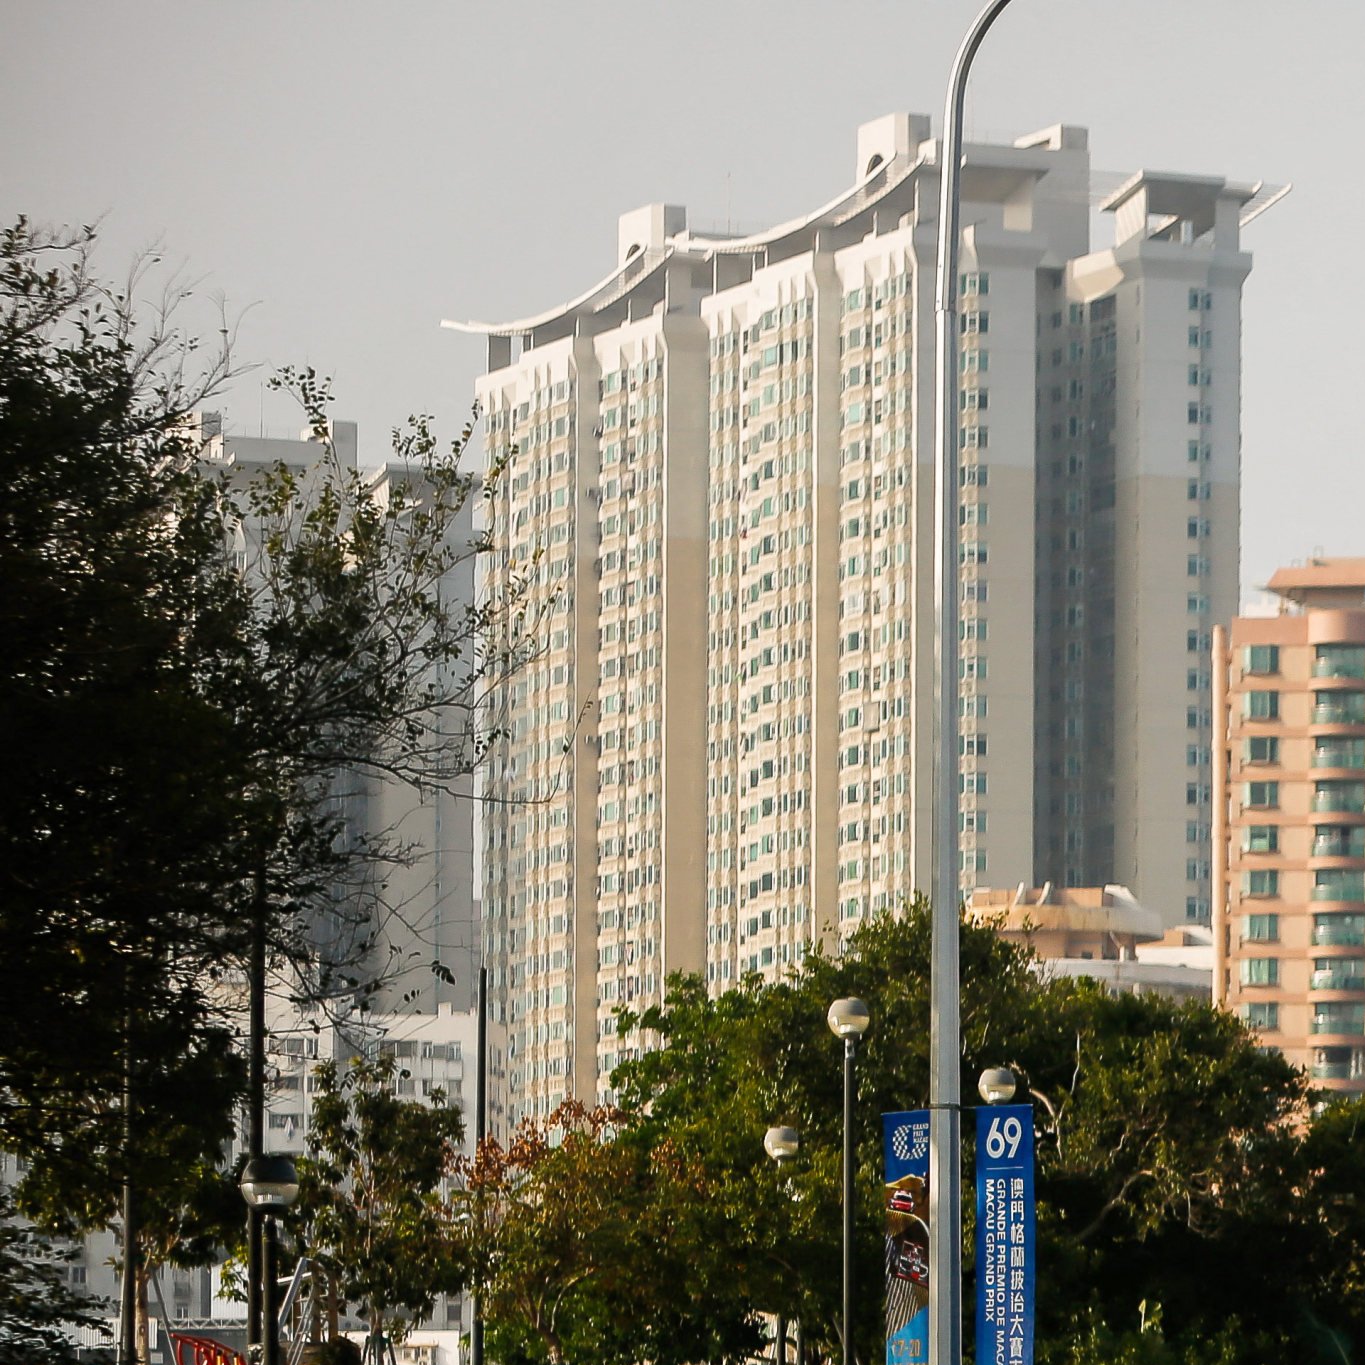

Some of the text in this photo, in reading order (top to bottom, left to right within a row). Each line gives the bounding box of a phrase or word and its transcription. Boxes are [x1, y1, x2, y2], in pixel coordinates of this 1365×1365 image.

[986, 1117, 1022, 1159] 69
[997, 1179, 1006, 1241] GRANDE
[986, 1179, 995, 1322] MACAU GRAND PRIX
[996, 1307, 1005, 1327] DE
